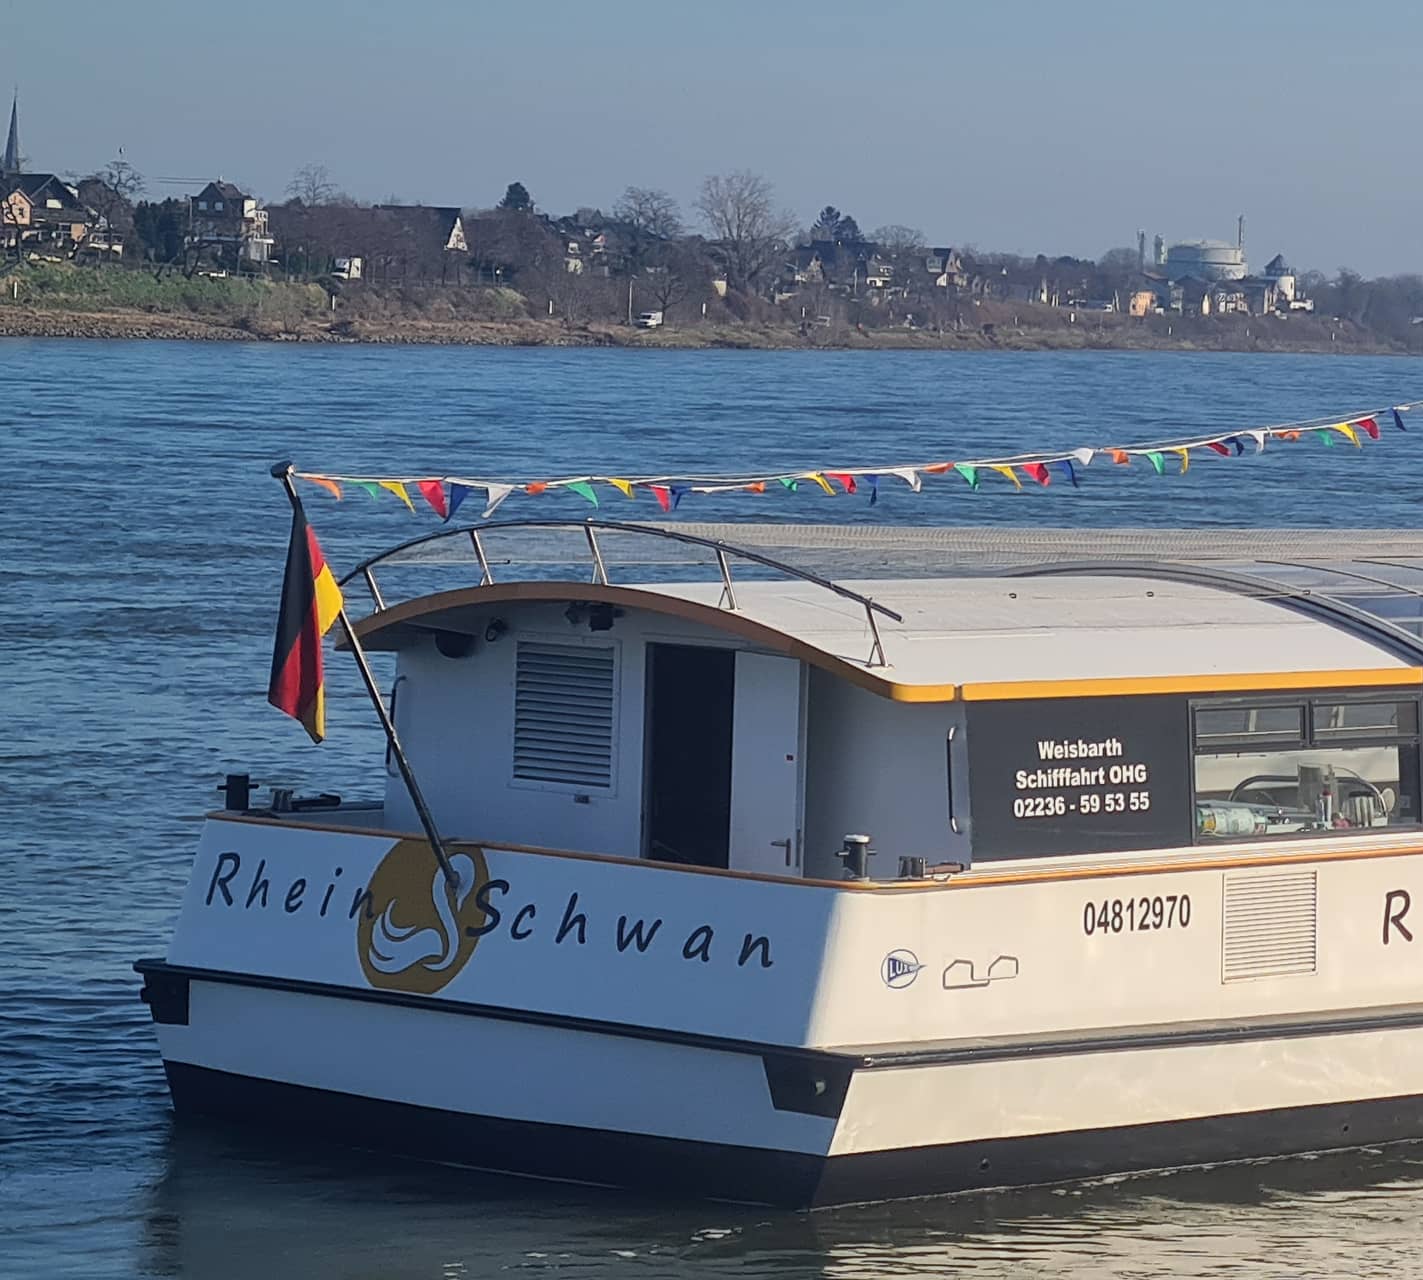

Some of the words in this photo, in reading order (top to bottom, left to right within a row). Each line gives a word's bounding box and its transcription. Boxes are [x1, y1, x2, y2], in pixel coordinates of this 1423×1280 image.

[1038, 738, 1122, 760] Weisbarth
[1016, 768, 1105, 789] Schifffahrt
[1109, 764, 1147, 785] OHG
[1013, 798, 1065, 818] 02236
[1080, 795, 1099, 814] 59
[1104, 793, 1124, 813] 53
[1129, 792, 1150, 811] 55
[205, 851, 374, 919] Rhein
[465, 879, 774, 969] Schwan
[1083, 894, 1191, 936] 04812970
